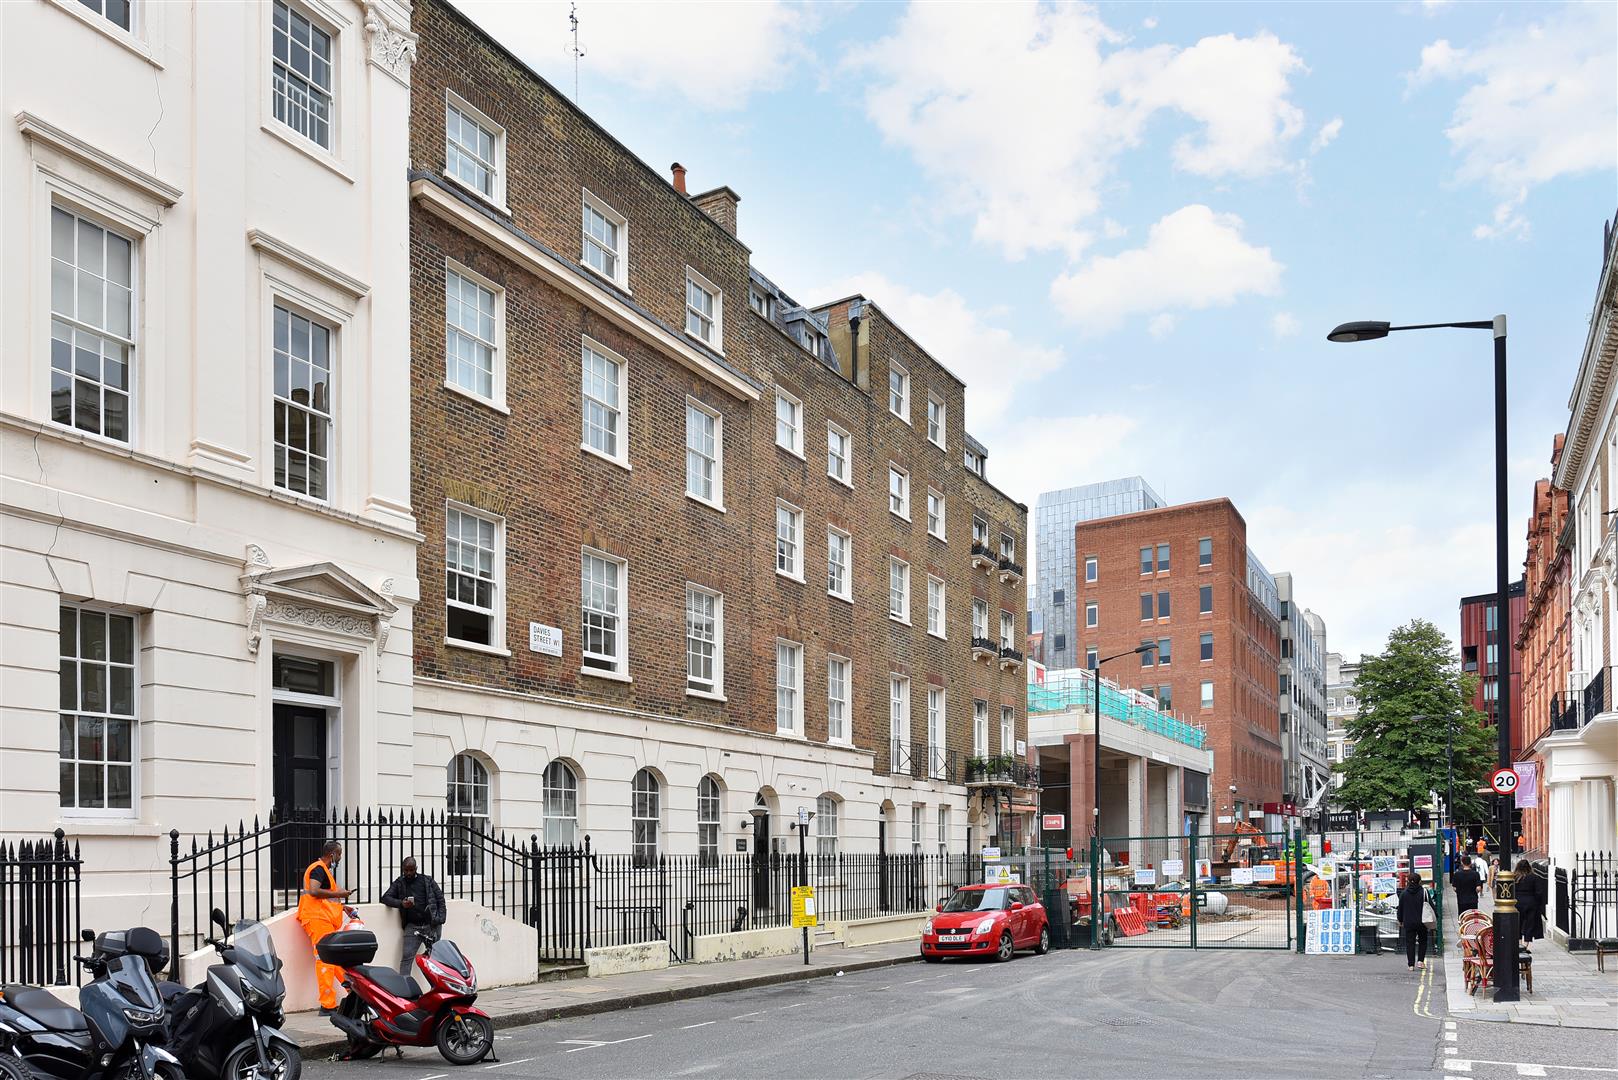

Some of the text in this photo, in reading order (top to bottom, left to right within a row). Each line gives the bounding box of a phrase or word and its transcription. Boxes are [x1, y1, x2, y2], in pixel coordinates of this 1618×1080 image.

[533, 626, 551, 636] DAVIES
[533, 634, 560, 647] STREET W1
[1496, 775, 1516, 787] 20
[1308, 911, 1317, 952] PYRAMID
